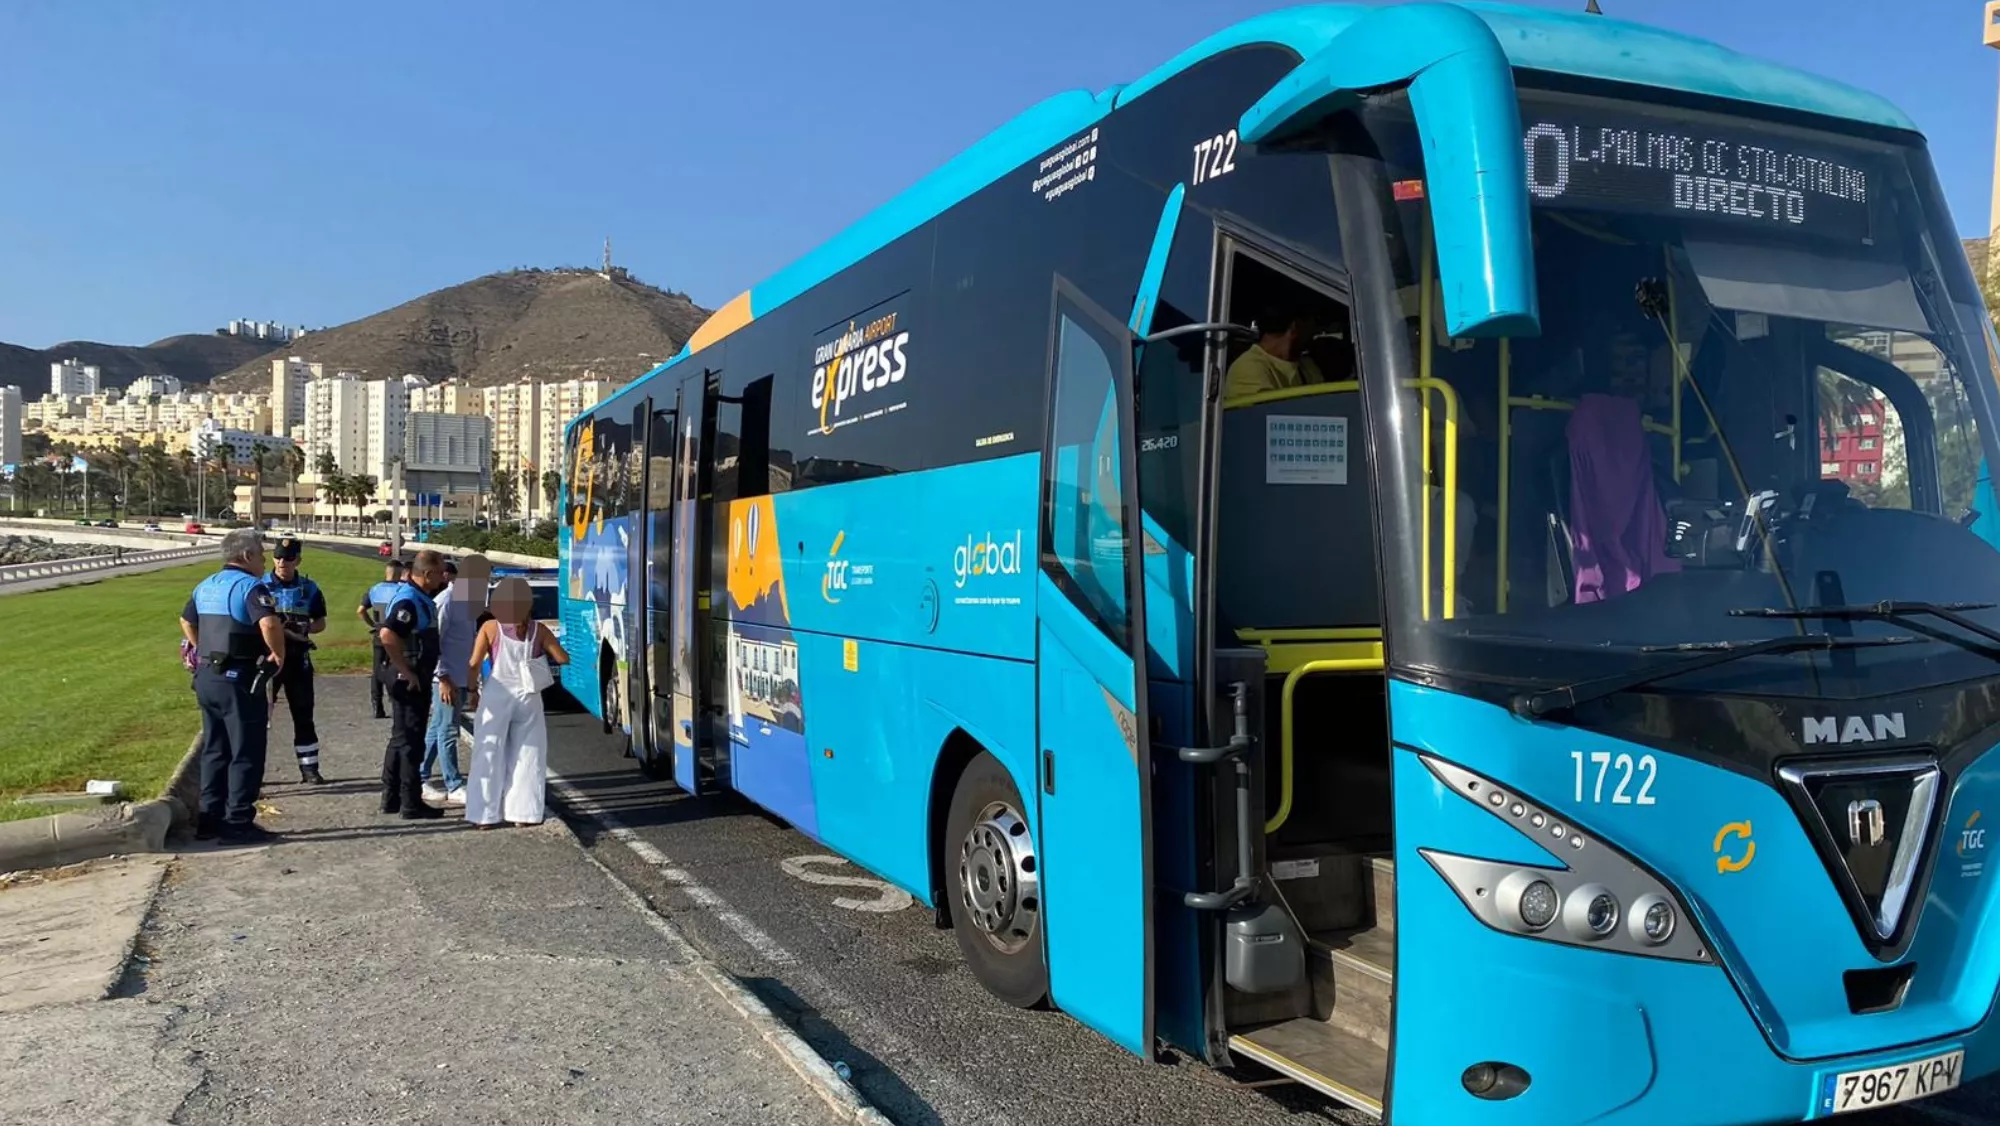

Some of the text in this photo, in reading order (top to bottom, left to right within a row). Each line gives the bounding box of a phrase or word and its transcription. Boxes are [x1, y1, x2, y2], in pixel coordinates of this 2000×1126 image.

[1192, 129, 1237, 185] 1722
[1703, 140, 1729, 176] GC
[1675, 174, 1804, 224] DIRECTO
[815, 312, 897, 365] GRAN CANARIA AIRPORT
[811, 332, 909, 432] express
[826, 560, 849, 590] TGC
[954, 528, 1021, 588] global
[1802, 712, 1906, 744] MAN
[1570, 751, 1657, 804] 1722
[1962, 829, 1985, 849] TGC
[1824, 1098, 1832, 1107] E
[1842, 1055, 1959, 1108] 7967 KPV
